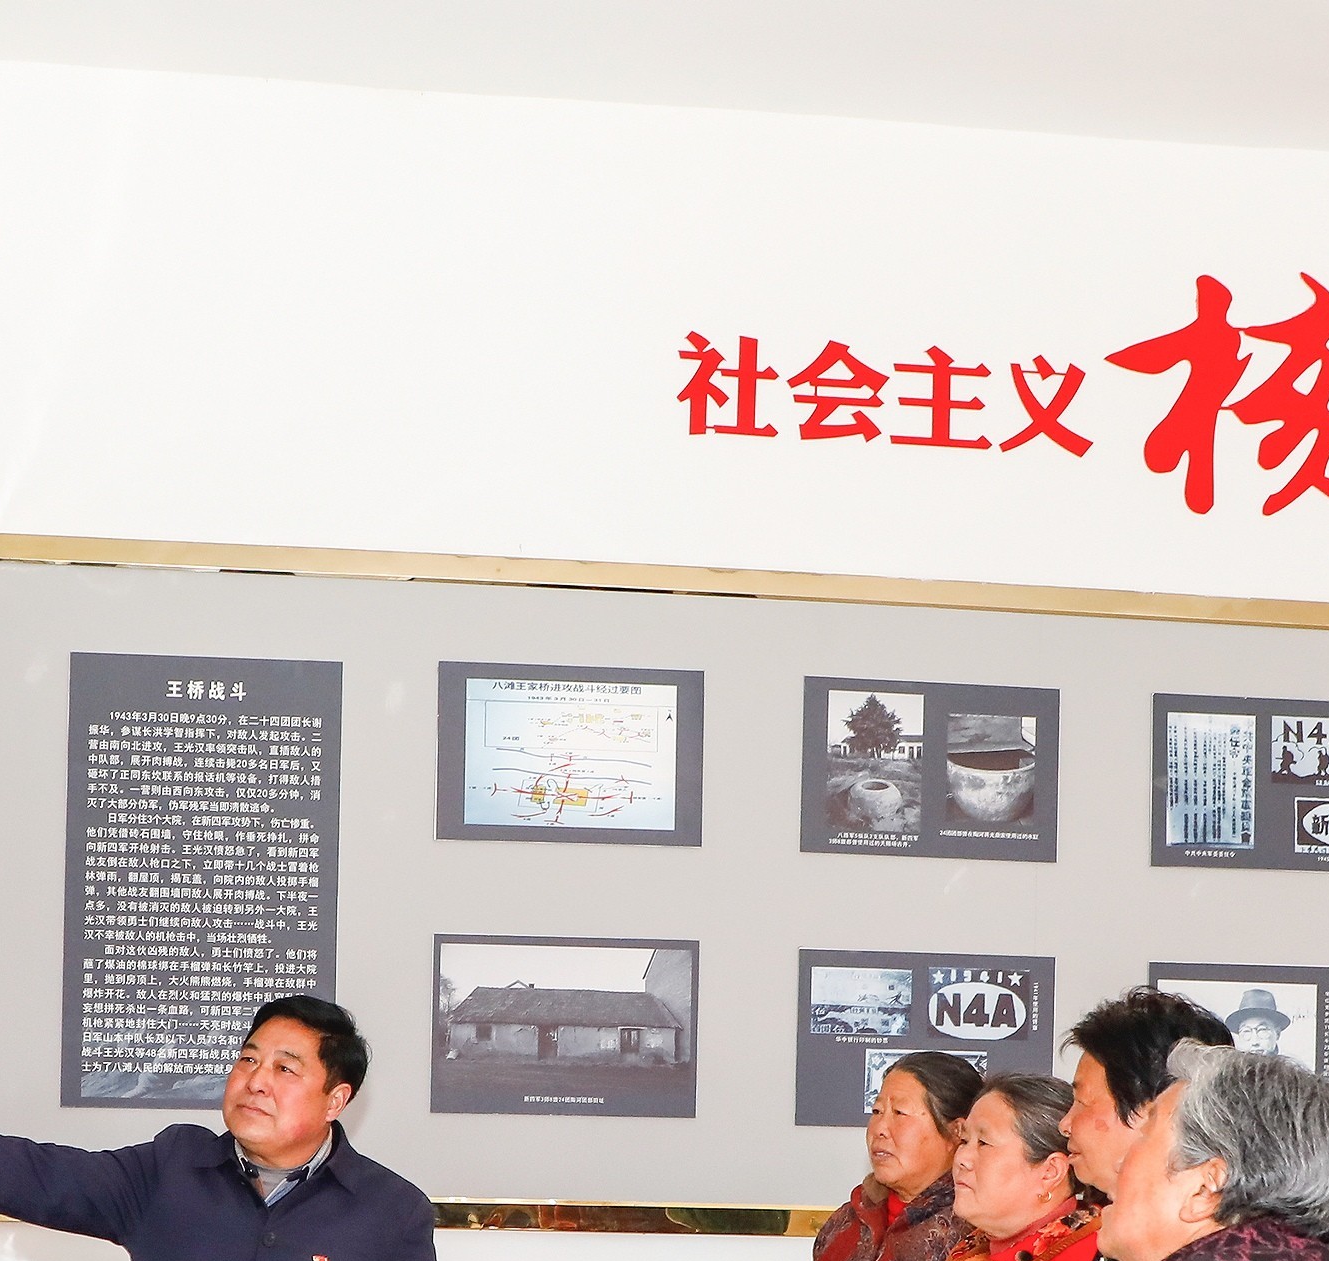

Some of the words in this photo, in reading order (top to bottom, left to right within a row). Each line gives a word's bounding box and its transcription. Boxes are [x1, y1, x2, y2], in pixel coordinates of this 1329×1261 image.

[676, 331, 1093, 457] 社会主义
[166, 680, 247, 701] 王桥战斗
[936, 993, 1017, 1028] N4A
